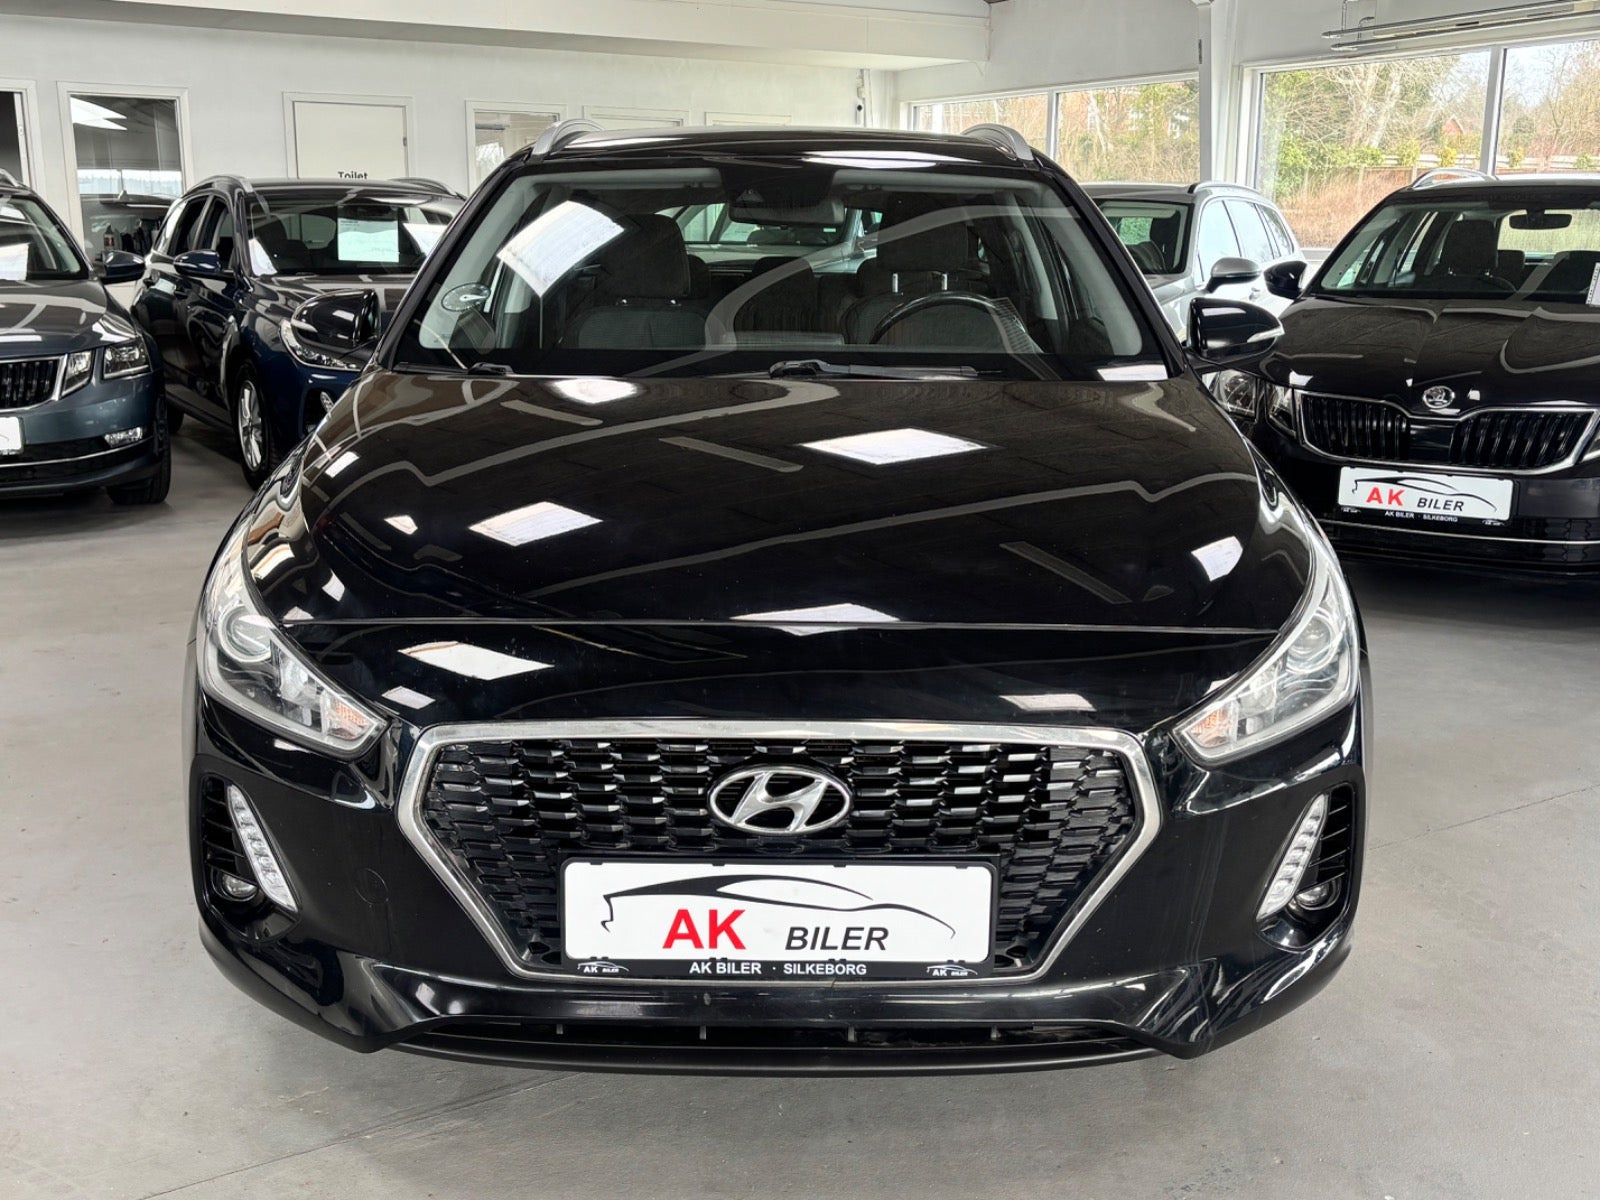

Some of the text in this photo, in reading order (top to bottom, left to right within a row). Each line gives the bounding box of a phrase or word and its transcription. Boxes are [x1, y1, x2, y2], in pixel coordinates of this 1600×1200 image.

[1366, 487, 1465, 512] AK BILER
[1395, 511, 1415, 519] BILER
[661, 908, 889, 951] AK BILER
[689, 961, 867, 976] AK BILER SILKEBORG
[932, 969, 948, 977] AK
